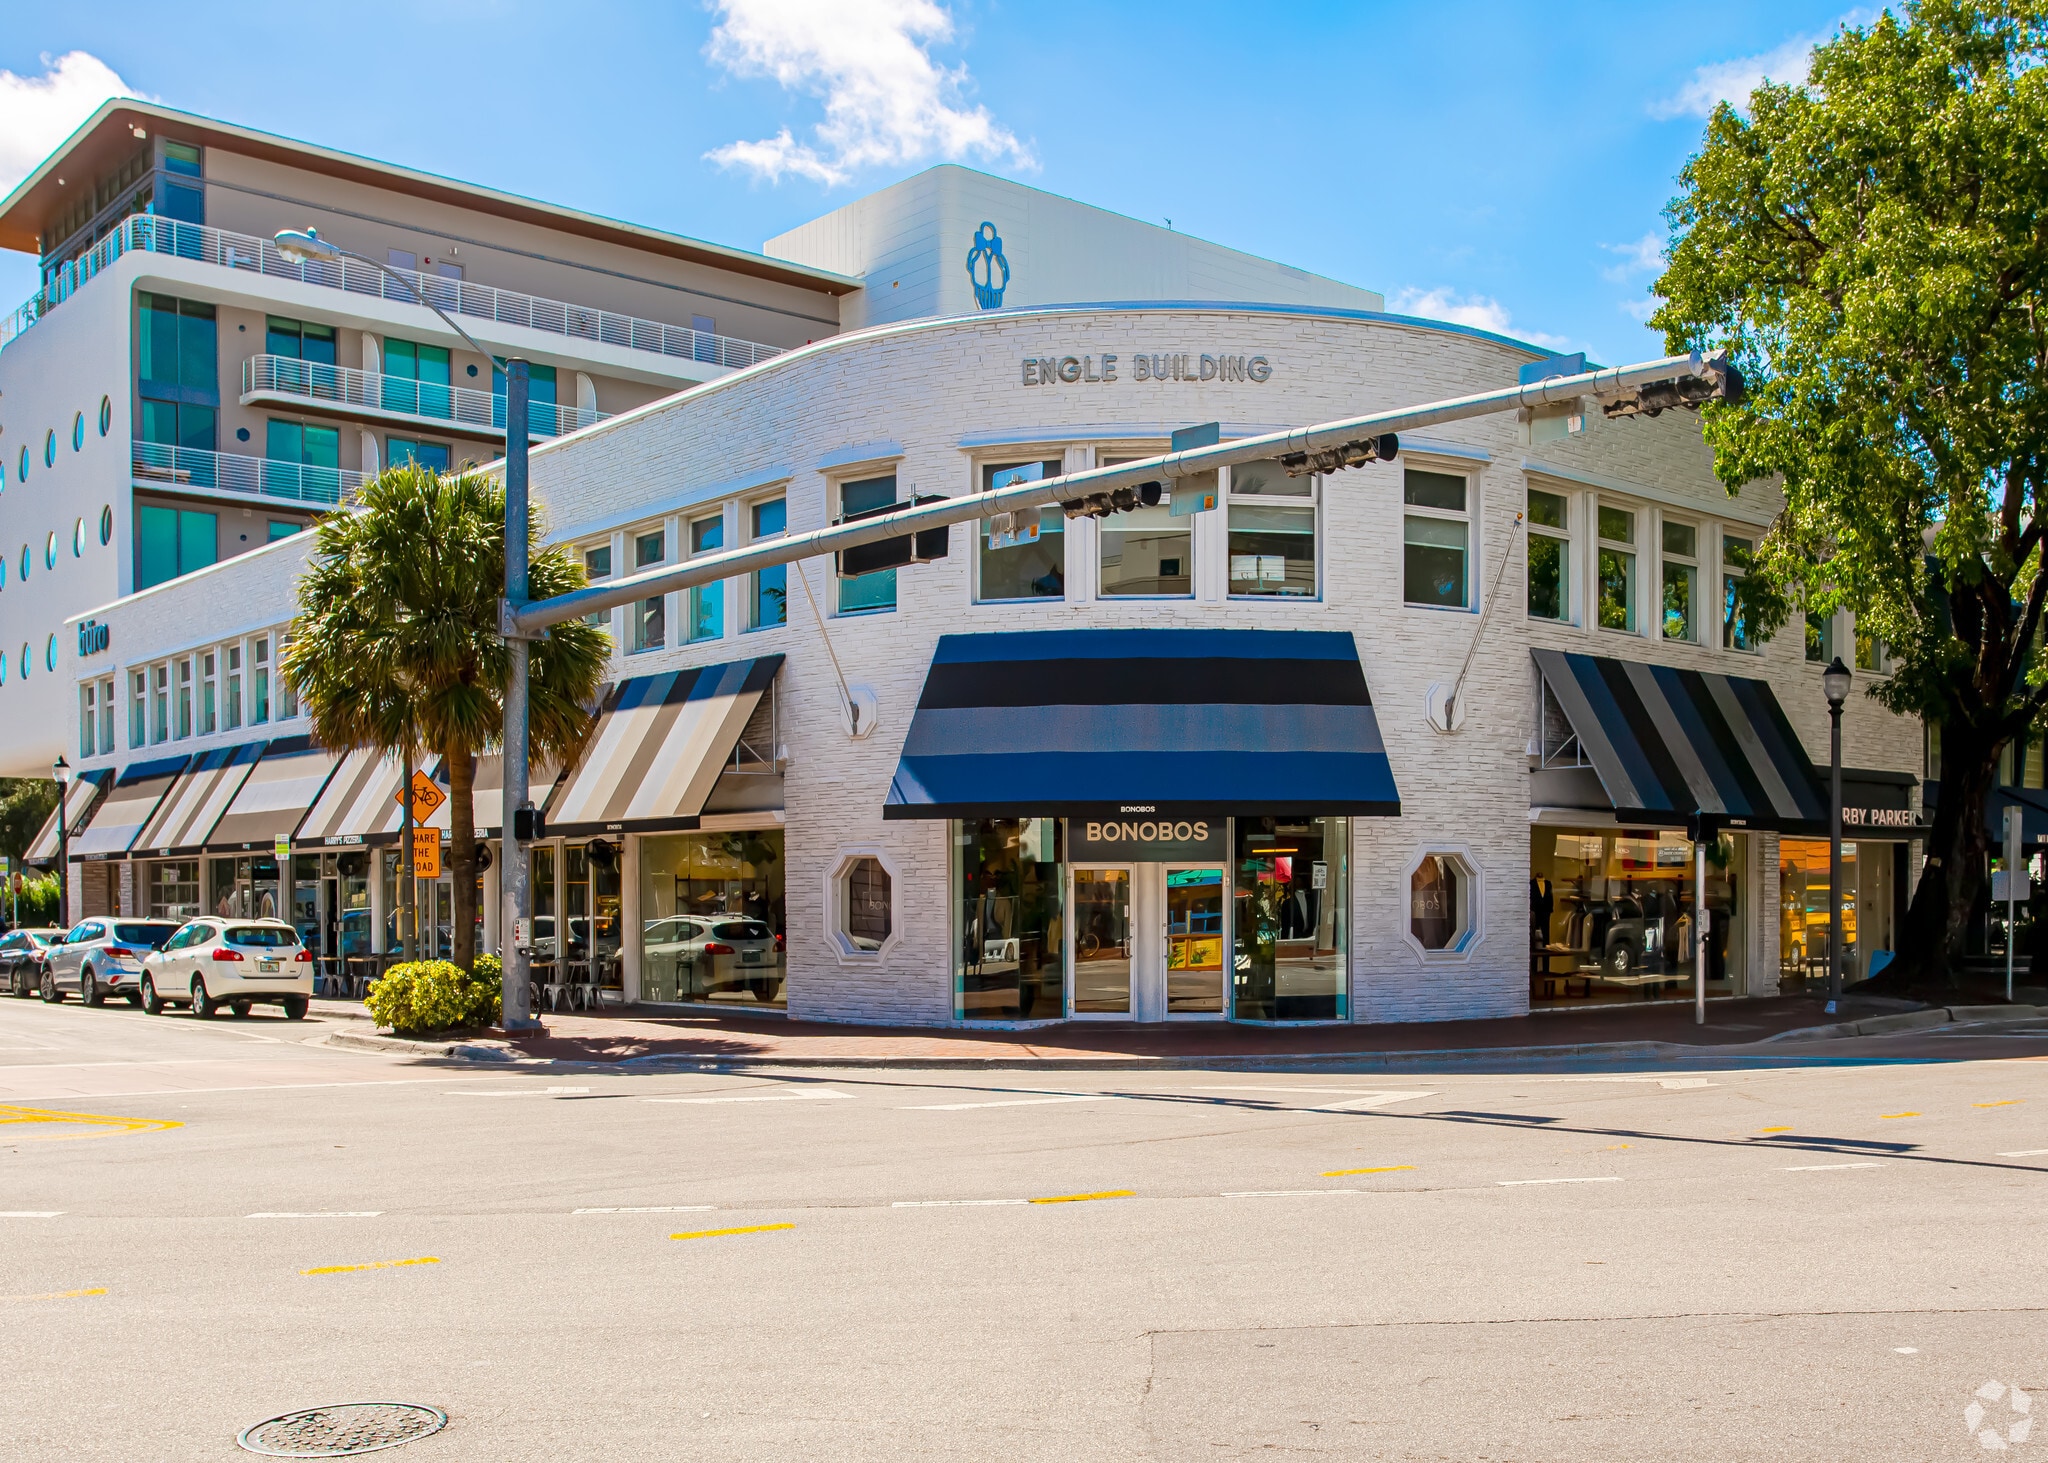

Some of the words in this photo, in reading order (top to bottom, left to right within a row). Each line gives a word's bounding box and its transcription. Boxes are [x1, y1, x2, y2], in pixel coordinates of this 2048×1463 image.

[1022, 354, 1118, 386] ENGLE
[1134, 353, 1273, 383] BUILDING
[78, 619, 110, 657] büro
[1842, 807, 1867, 825] RBY
[1871, 808, 1917, 826] PARKER
[413, 833, 436, 843] HARE
[1086, 821, 1209, 842] BONOBOS
[414, 848, 430, 857] THE
[415, 862, 433, 872] OAD
[869, 901, 892, 911] BON
